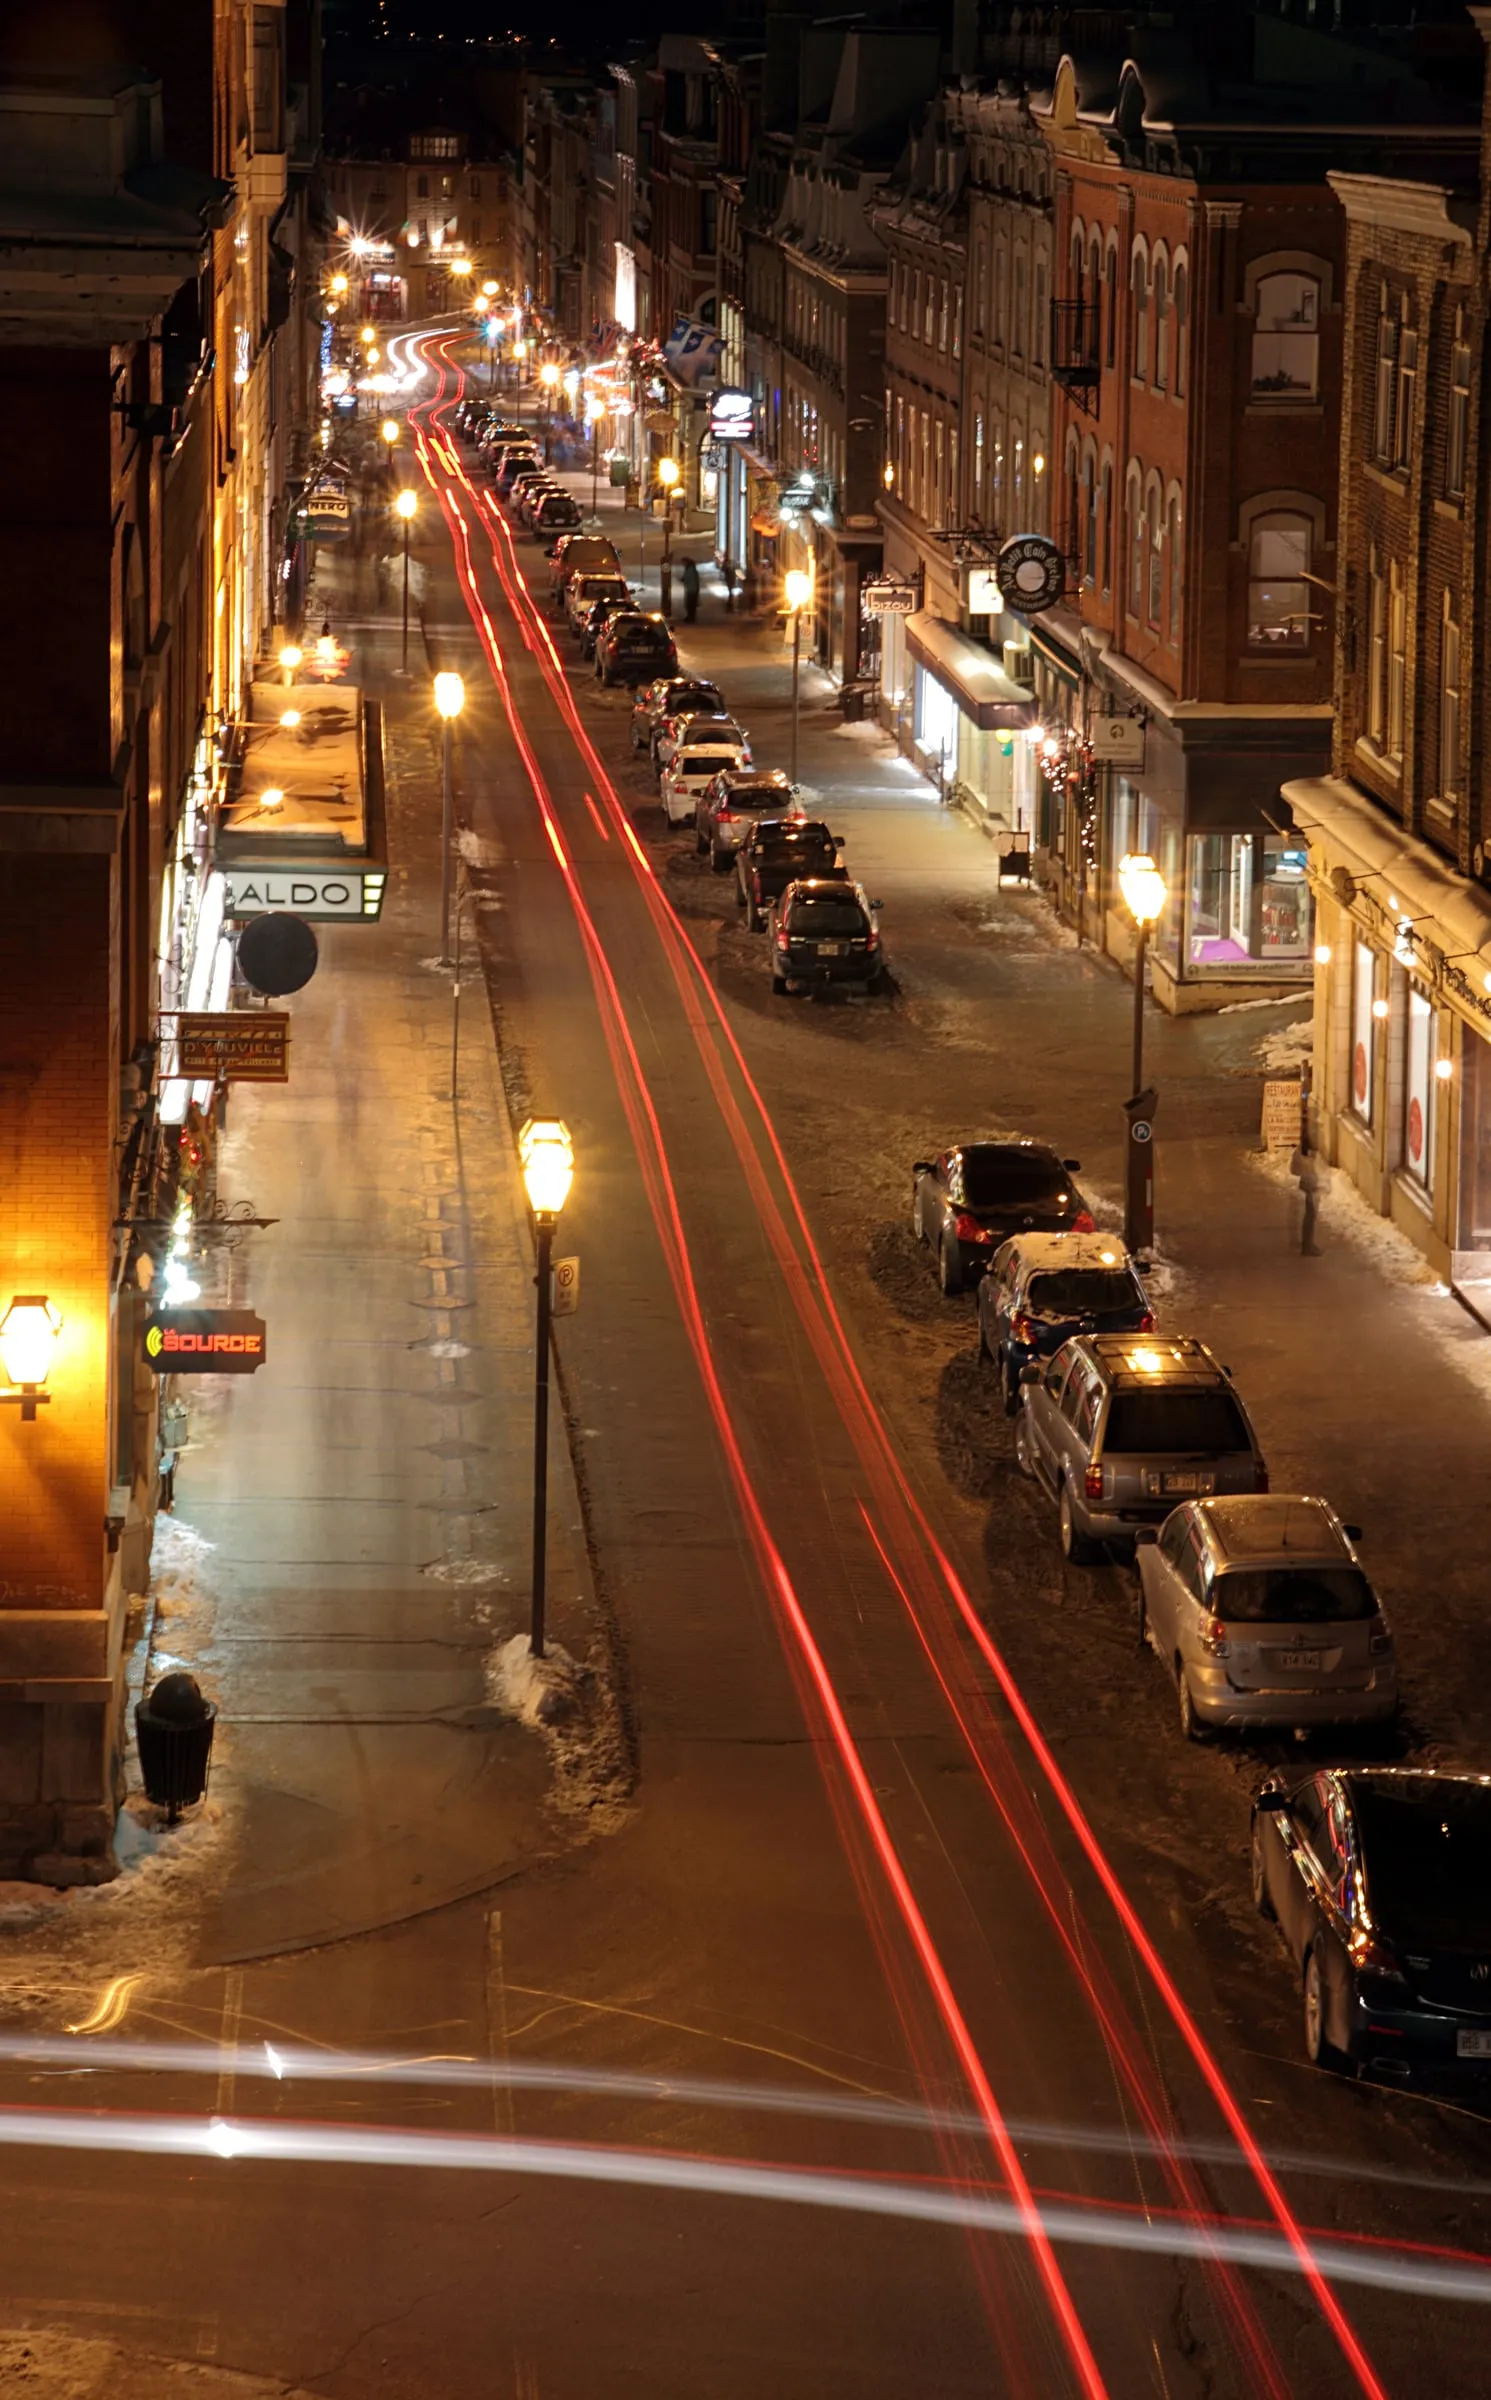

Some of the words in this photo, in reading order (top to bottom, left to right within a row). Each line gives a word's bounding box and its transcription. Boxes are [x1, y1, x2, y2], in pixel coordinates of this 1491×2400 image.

[310, 502, 346, 511] NERO
[1024, 543, 1047, 560] Coin
[238, 883, 350, 905] ALDO
[163, 1335, 261, 1352] SOURCE
